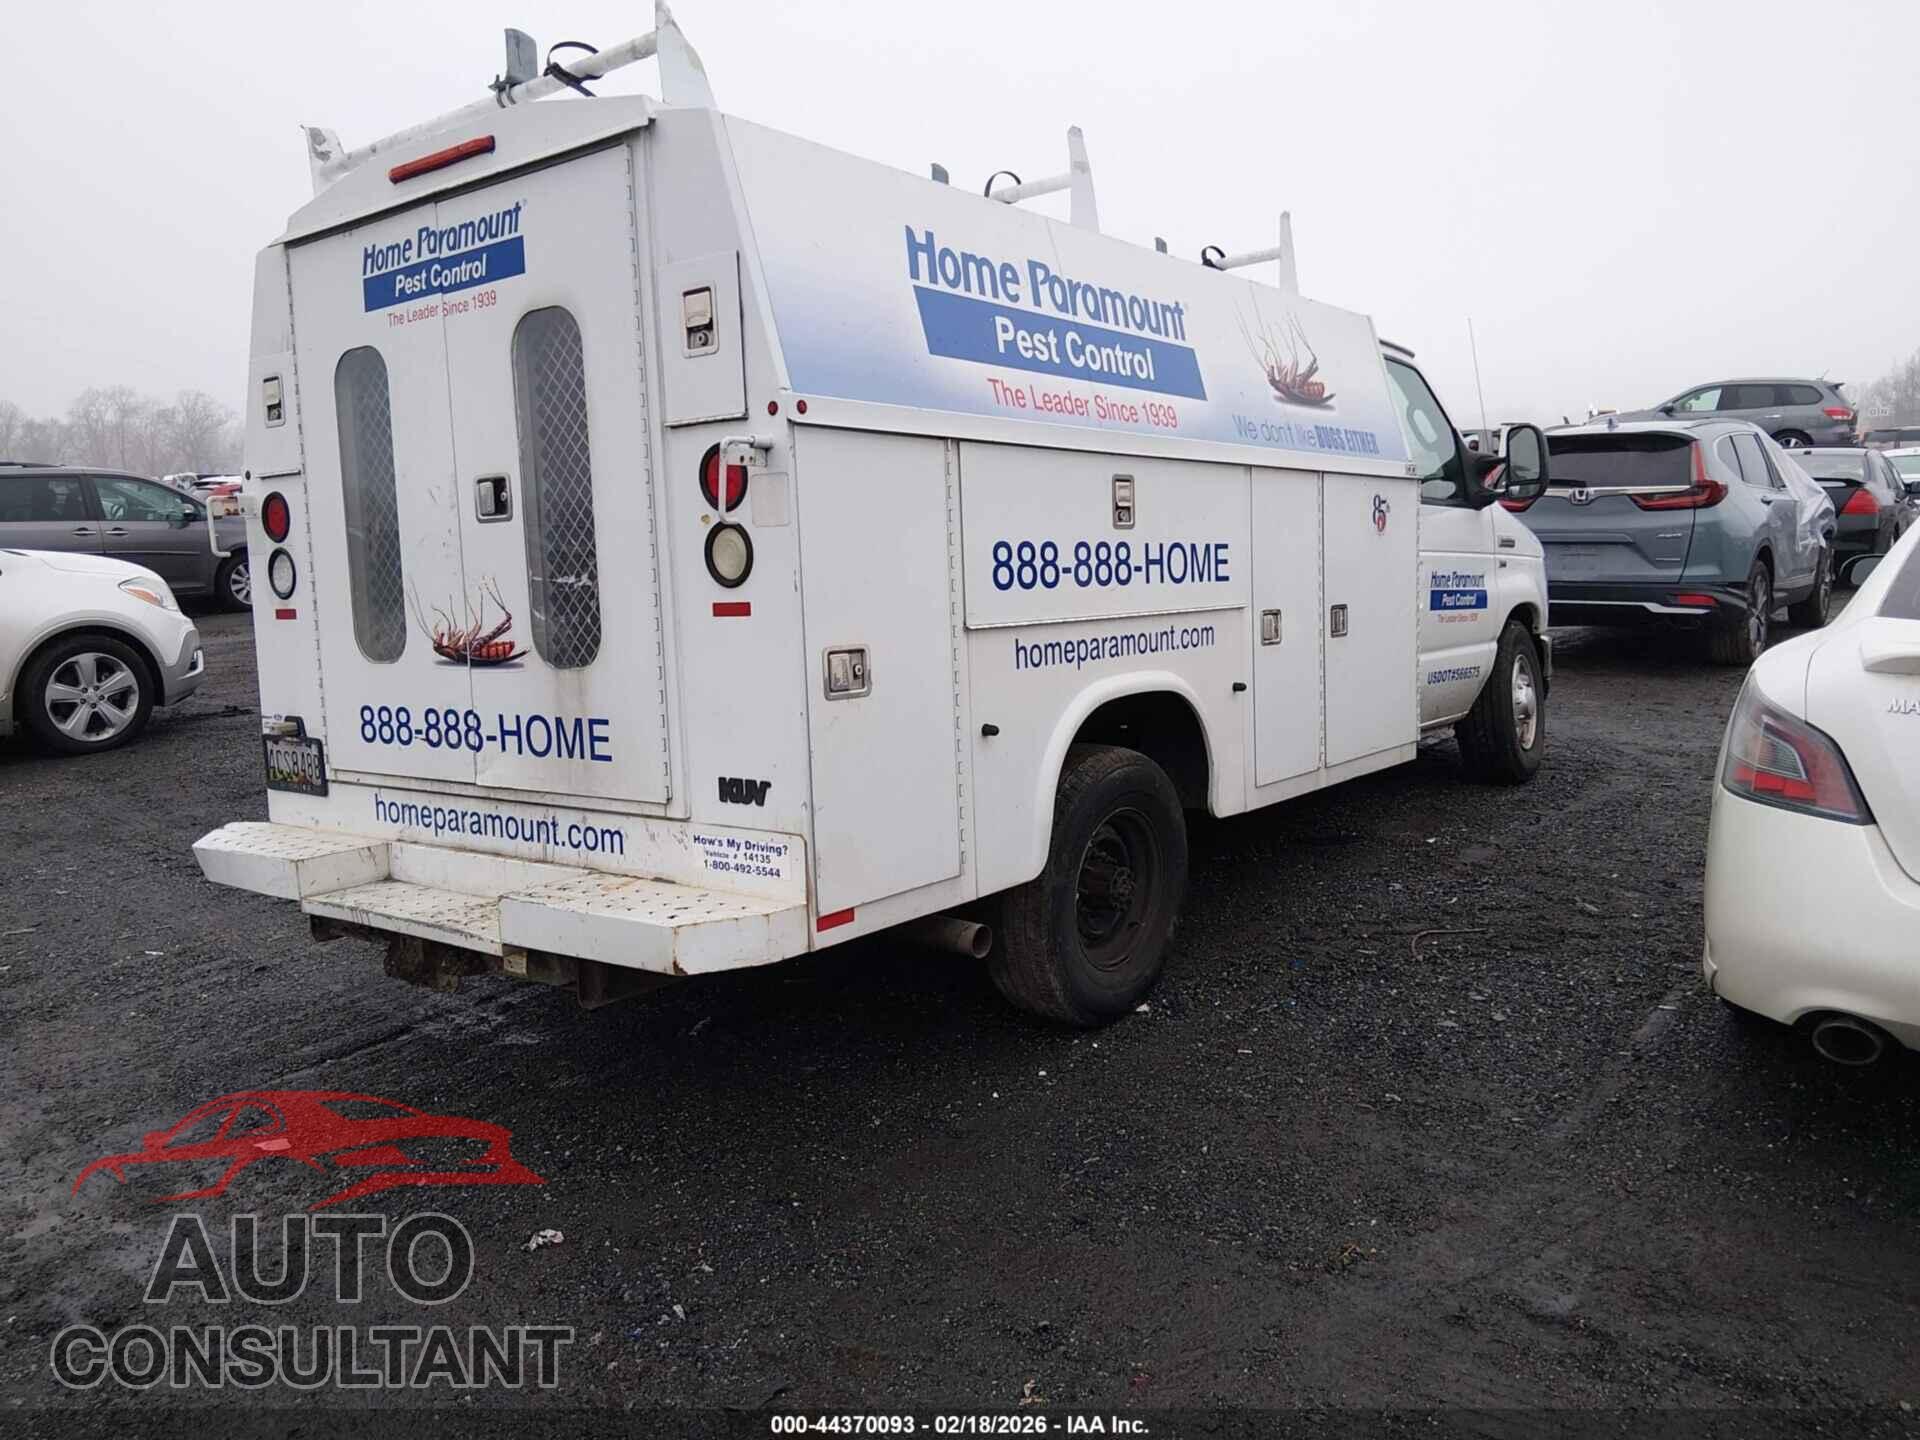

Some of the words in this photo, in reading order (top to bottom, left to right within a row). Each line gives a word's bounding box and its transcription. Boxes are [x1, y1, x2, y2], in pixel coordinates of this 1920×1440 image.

[362, 237, 413, 277] Home
[417, 201, 522, 259] Paramount
[395, 269, 427, 298] Pest
[430, 253, 487, 288] Control
[904, 224, 1021, 304] Home
[1026, 259, 1187, 342] Paramount
[388, 312, 405, 328] The
[407, 304, 439, 323] Leader
[441, 299, 470, 318] Since
[472, 289, 497, 311] 1939
[993, 315, 1061, 365] Pest
[1064, 331, 1156, 381] Control
[987, 378, 1027, 408] The
[1031, 384, 1091, 418] Leader
[1095, 395, 1139, 425] Since
[1141, 402, 1179, 429] 1939
[991, 539, 1231, 592] 888-888-HOME
[1014, 624, 1215, 671] homeparamount.com
[359, 704, 614, 763] 888-888-HOME
[374, 792, 625, 856] homeparamount.com
[693, 834, 723, 847] How's
[726, 838, 741, 852] My
[744, 840, 788, 857] Driving?
[704, 859, 781, 878] 1-800-492-5544
[743, 852, 771, 864] 14135
